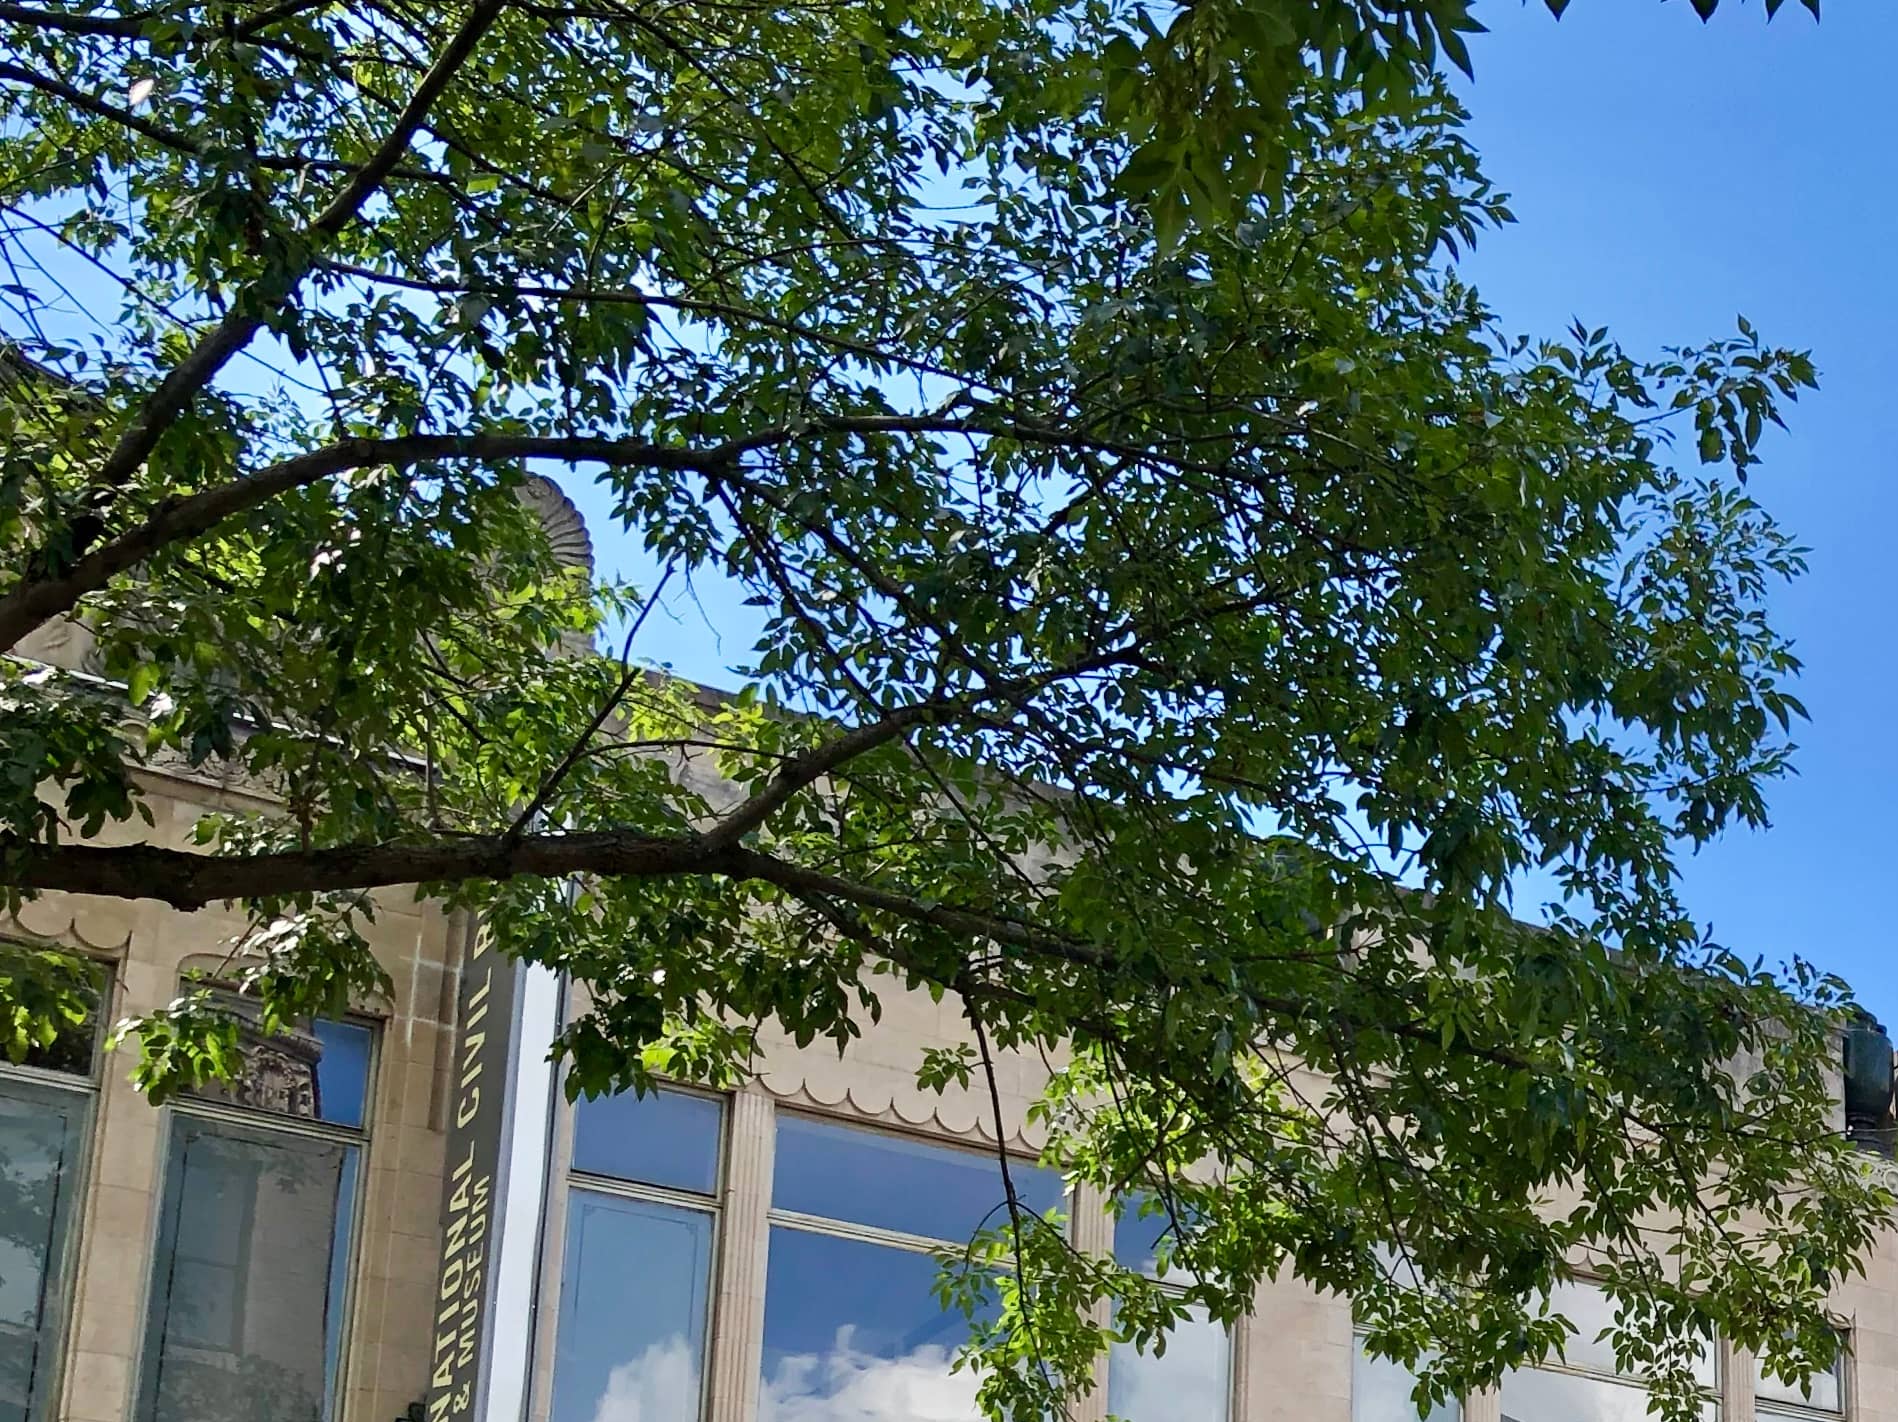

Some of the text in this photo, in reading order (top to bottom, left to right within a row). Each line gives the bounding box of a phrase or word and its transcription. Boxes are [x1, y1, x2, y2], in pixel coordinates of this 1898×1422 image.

[457, 967, 493, 1130] CIVIL
[457, 1175, 491, 1369] MUSEUM
[453, 1380, 471, 1412] &
